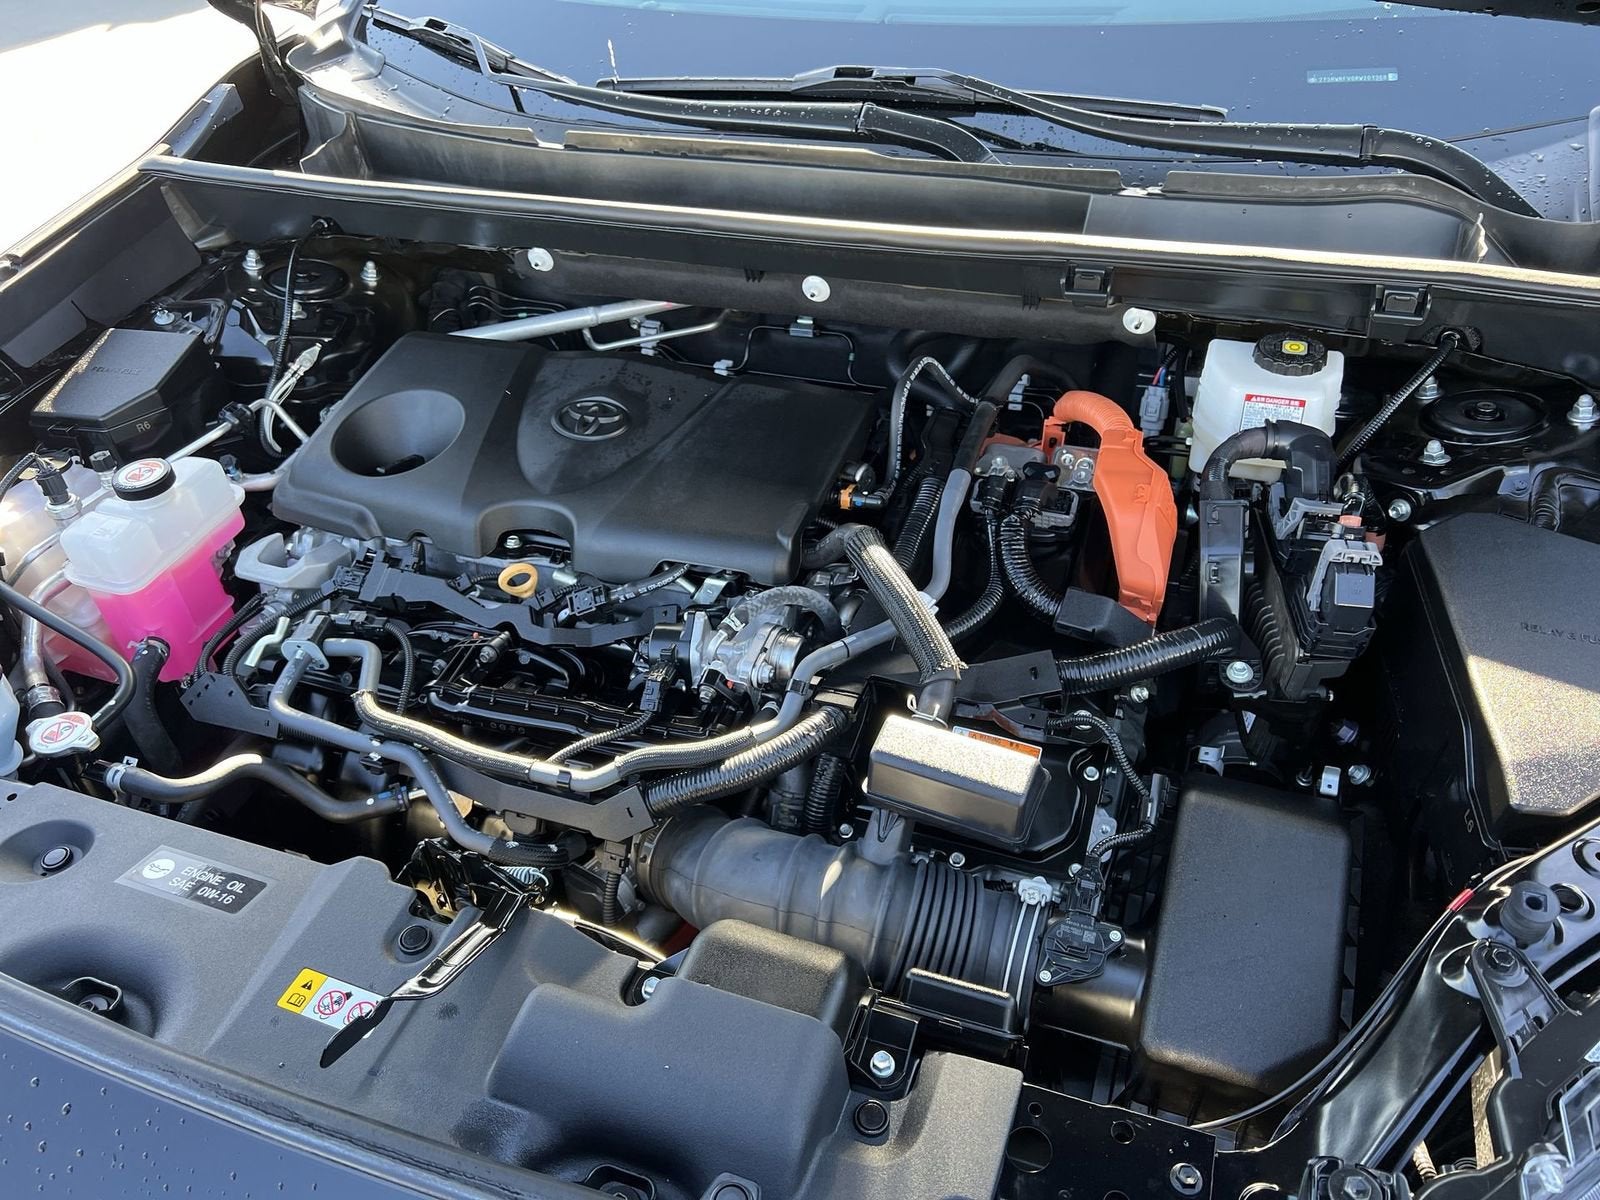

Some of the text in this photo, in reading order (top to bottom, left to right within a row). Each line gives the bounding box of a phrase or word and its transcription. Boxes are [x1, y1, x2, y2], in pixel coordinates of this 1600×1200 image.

[136, 421, 151, 432] R6
[1521, 622, 1563, 637] RELAY
[169, 877, 195, 891] SAE
[181, 866, 247, 894] ENGINE OIL
